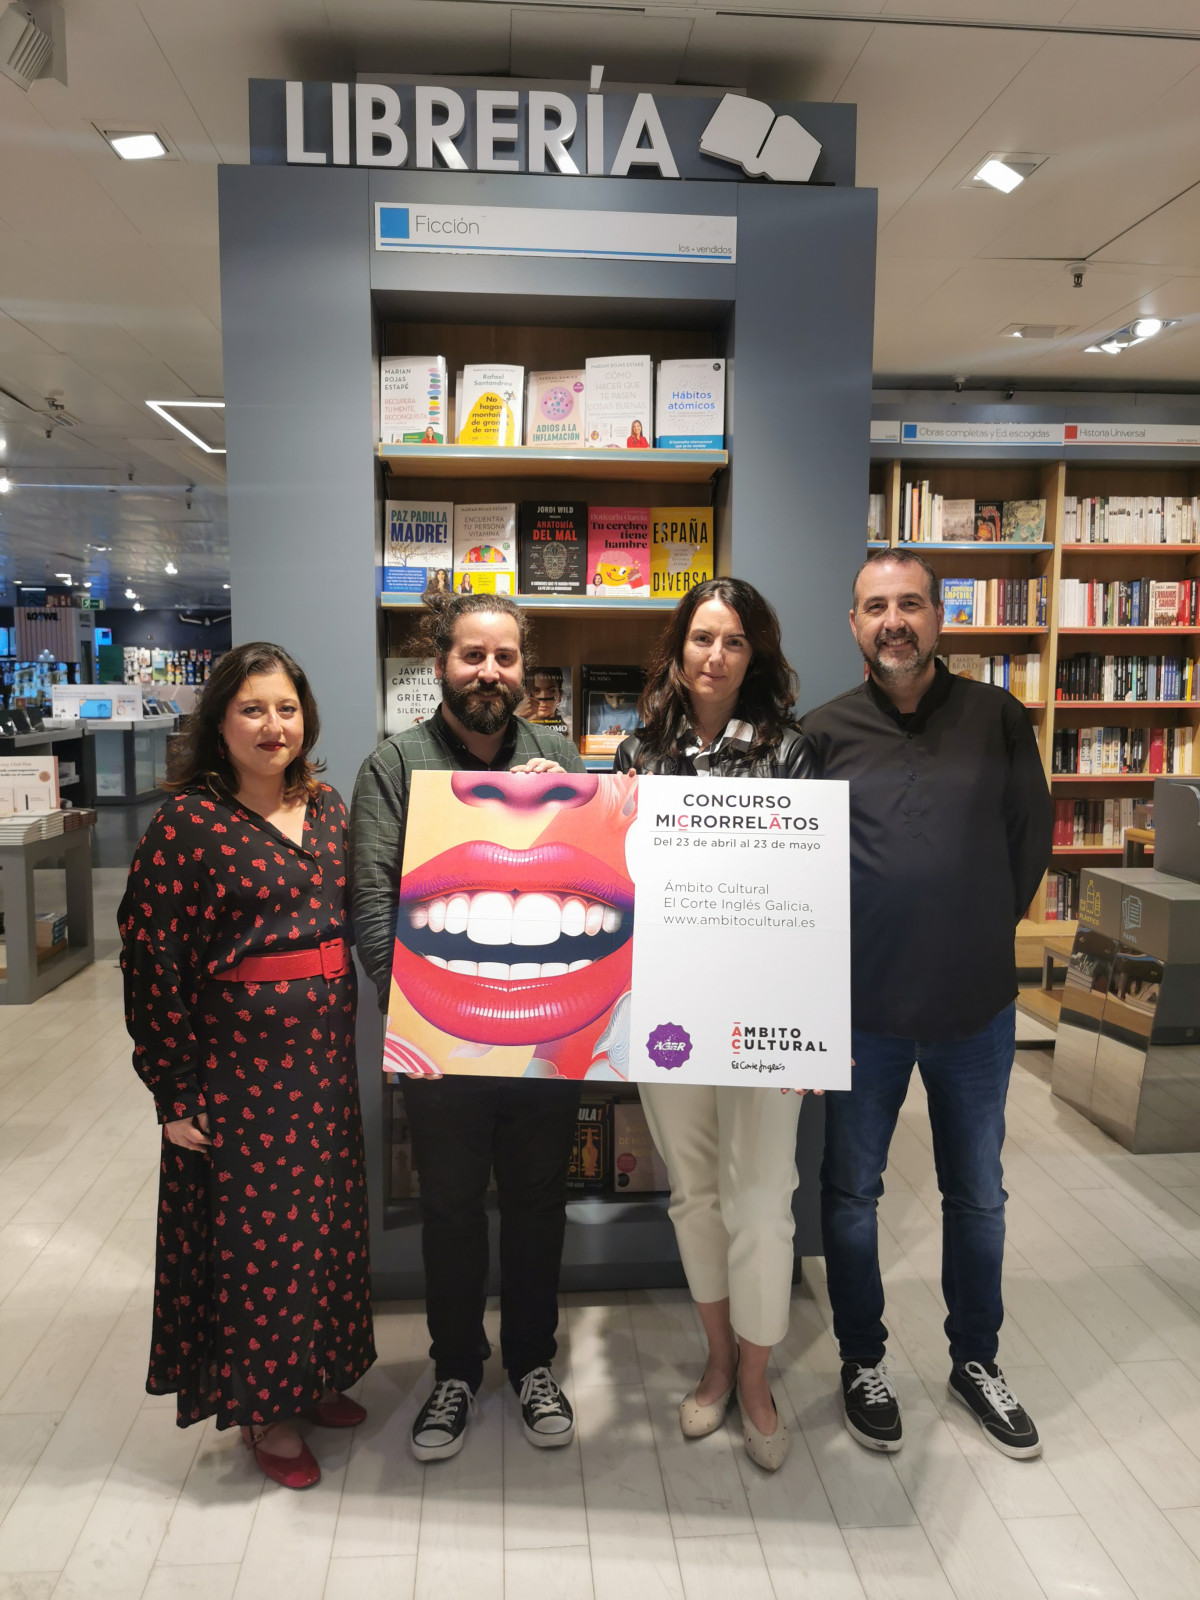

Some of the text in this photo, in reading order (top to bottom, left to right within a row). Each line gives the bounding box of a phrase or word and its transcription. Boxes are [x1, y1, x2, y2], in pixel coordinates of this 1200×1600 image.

[285, 65, 680, 178] LIBRERÍA
[415, 215, 480, 235] Ficción
[678, 243, 732, 254] los vendidos
[605, 370, 632, 379] CÓMO
[672, 391, 712, 400] Hábitos
[479, 403, 503, 411] hagas
[667, 400, 716, 410] atómicos
[536, 423, 577, 433] ADIÓS A LA
[919, 427, 945, 437] Obras
[945, 427, 989, 439] completas
[990, 429, 995, 438] y
[1008, 428, 1050, 439] escogidas
[1079, 428, 1146, 437] Historia Universal
[532, 432, 580, 442] INFLAMACIÓN
[391, 509, 448, 523] PAZ PADILLA
[536, 519, 574, 529] ANATOMÍA
[591, 521, 648, 530] Tu cerebro
[390, 523, 448, 543] MADRE!
[533, 530, 578, 541] DEL MAL
[620, 530, 648, 539] tiene
[653, 518, 708, 544] ESPAÑA
[604, 539, 648, 549] hambre
[951, 662, 978, 670] BEARD
[398, 667, 433, 676] JAVIER
[391, 677, 440, 686] CASTILLO
[396, 693, 436, 702] GRIETA
[682, 793, 792, 809] CONCURSO
[653, 837, 821, 852] Del 23 de abril al 23 de mayo
[664, 879, 769, 895] Ámbito Cultural
[663, 897, 813, 913] El Corte Inglés Galicia,
[663, 914, 816, 928] www.ambitocultural.es
[731, 1039, 828, 1055] CULTURAL
[731, 1059, 785, 1073] El Corte Inglés
